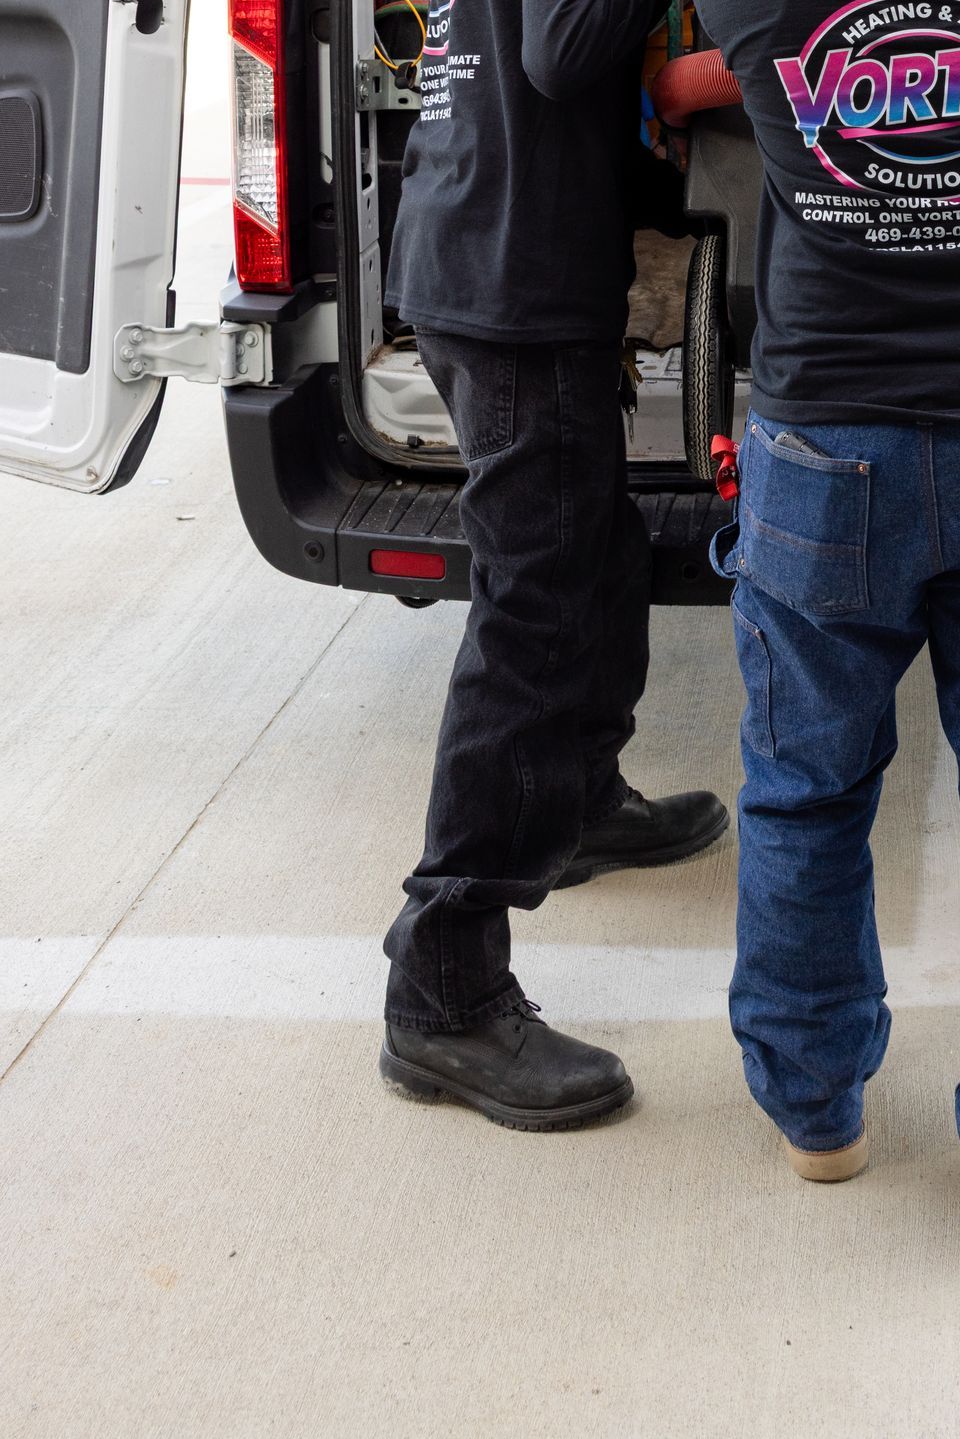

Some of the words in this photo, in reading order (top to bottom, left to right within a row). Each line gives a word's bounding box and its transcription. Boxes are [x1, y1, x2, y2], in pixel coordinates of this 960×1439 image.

[841, 2, 932, 45] HEATING
[938, 5, 954, 22] &
[423, 64, 446, 77] YOUR
[420, 79, 439, 91] ONE
[449, 68, 475, 80] TIME
[795, 192, 880, 208] MASTERING
[885, 197, 932, 209] YOUR
[802, 208, 874, 224] CONTROL
[879, 212, 913, 223] ONE
